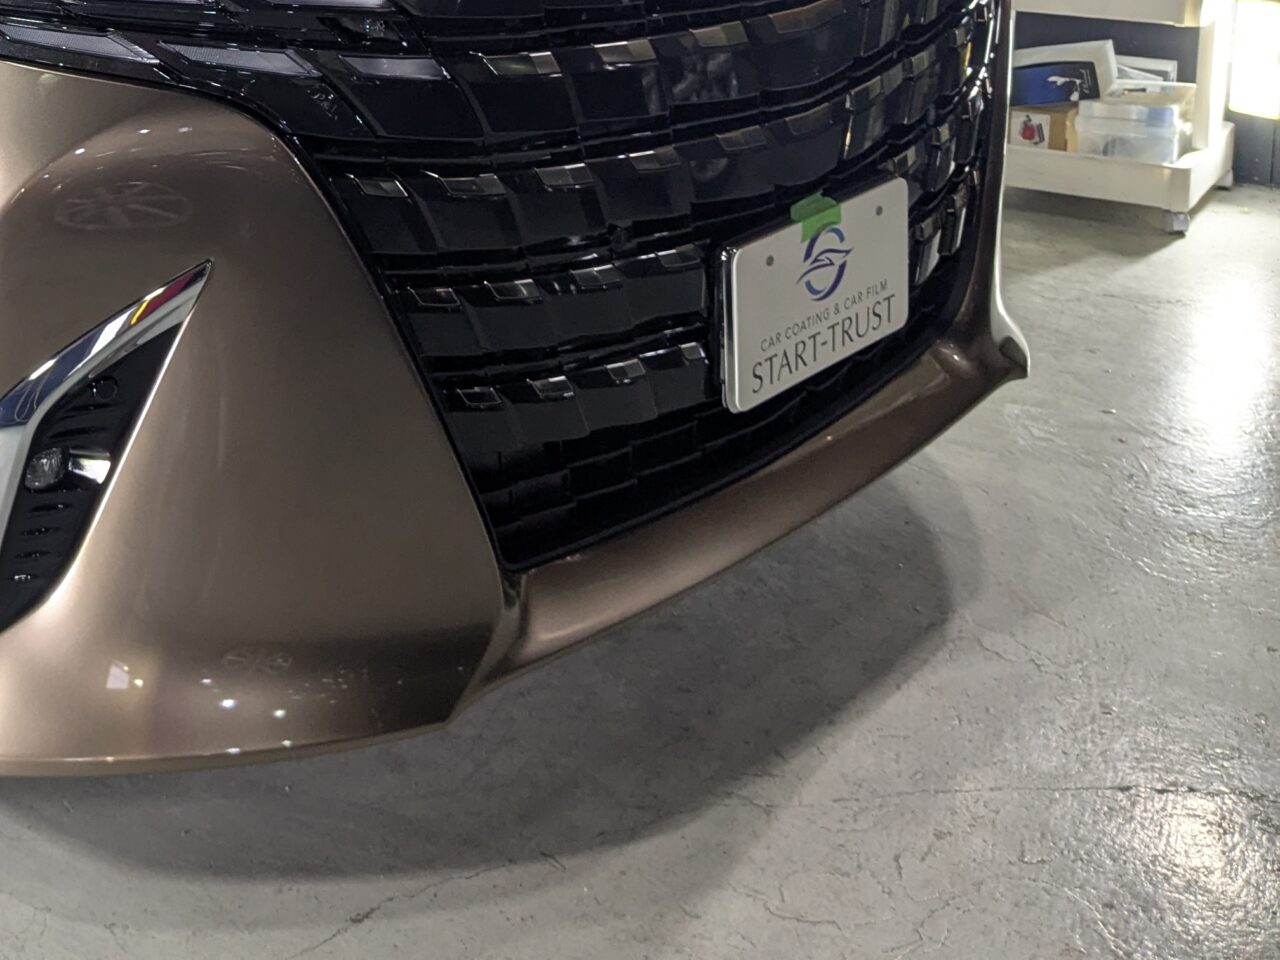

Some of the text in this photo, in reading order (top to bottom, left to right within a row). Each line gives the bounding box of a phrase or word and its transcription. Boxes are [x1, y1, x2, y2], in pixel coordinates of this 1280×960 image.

[751, 294, 896, 394] START-TRUST
[760, 279, 888, 352] CAR COATING & CAR FILM
